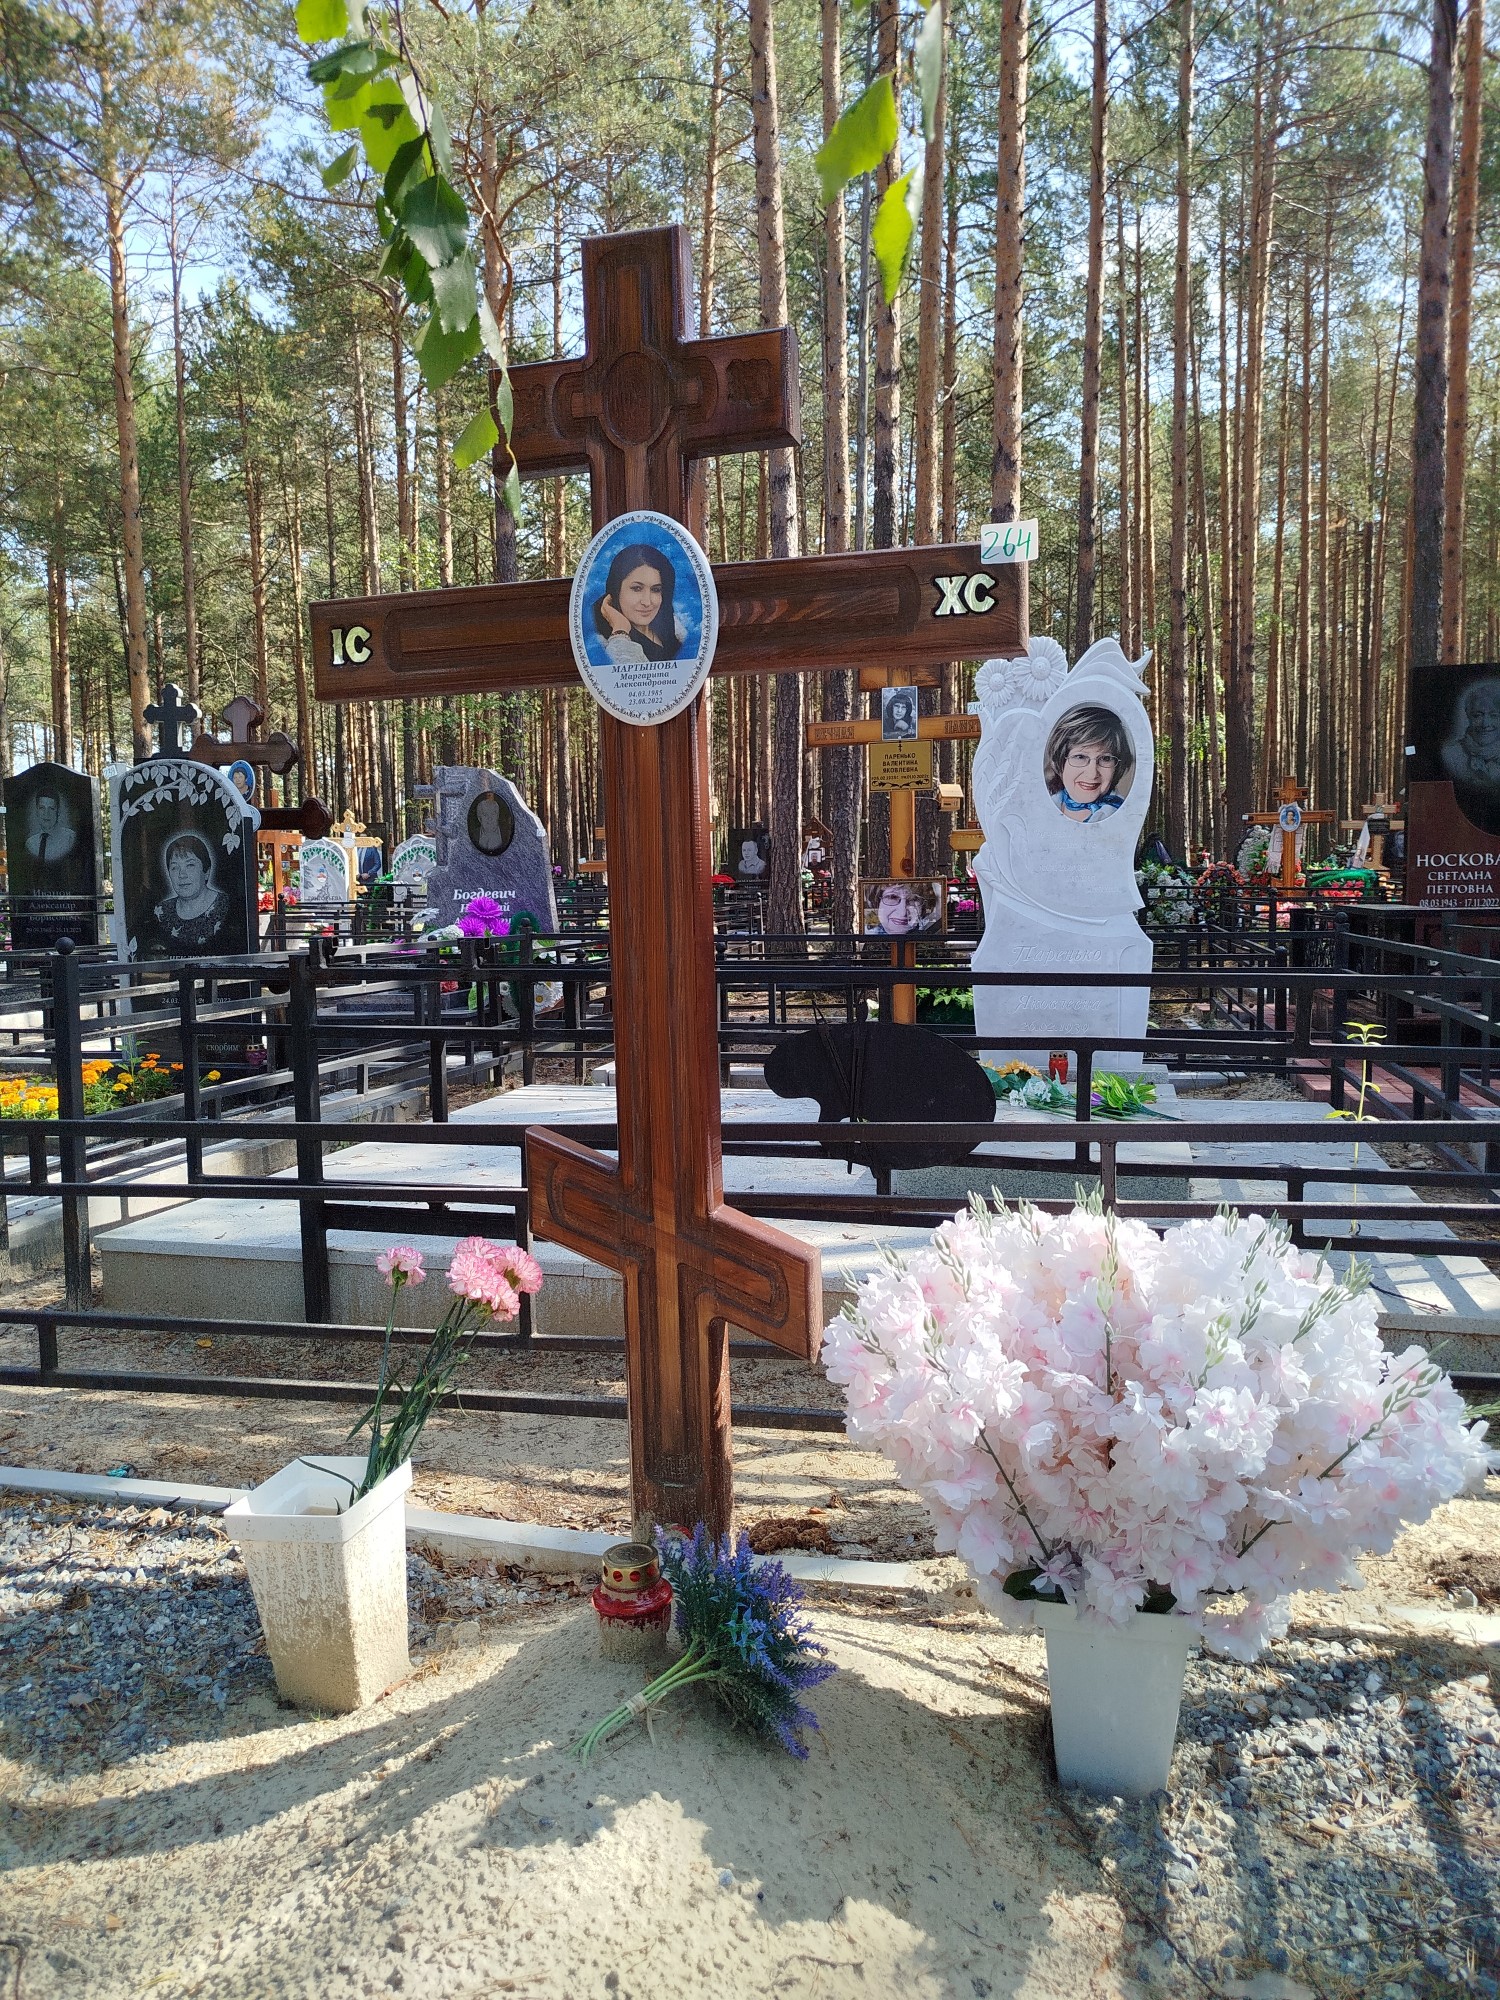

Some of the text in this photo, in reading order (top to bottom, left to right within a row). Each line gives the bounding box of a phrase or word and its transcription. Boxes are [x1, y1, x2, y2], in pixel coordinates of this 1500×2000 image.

[982, 527, 1032, 559] 264
[934, 573, 996, 616] ХС
[611, 661, 678, 673] МАРТЫНОВА
[620, 672, 669, 681] Маргарита
[613, 680, 677, 689] Александровна
[628, 689, 663, 698] 04.03.1985
[628, 697, 663, 706] 23.08.2022
[884, 752, 916, 760] ПАРЕНЬКО
[882, 766, 918, 774] ЯКОВЛЕВНА
[1428, 871, 1492, 880] СВЕТЛАНА
[453, 888, 516, 900] Богдевич
[1427, 884, 1493, 894] ПЕТРОВНА
[29, 902, 76, 910] Александр
[1419, 898, 1457, 907] 08.03.1943
[1464, 897, 1500, 907] 17.11.2022
[1007, 945, 1102, 967] Паренько
[1008, 995, 1102, 1015] Яковлевна
[1019, 1021, 1090, 1034] 26.02.1939
[206, 1042, 240, 1053] скорбим
